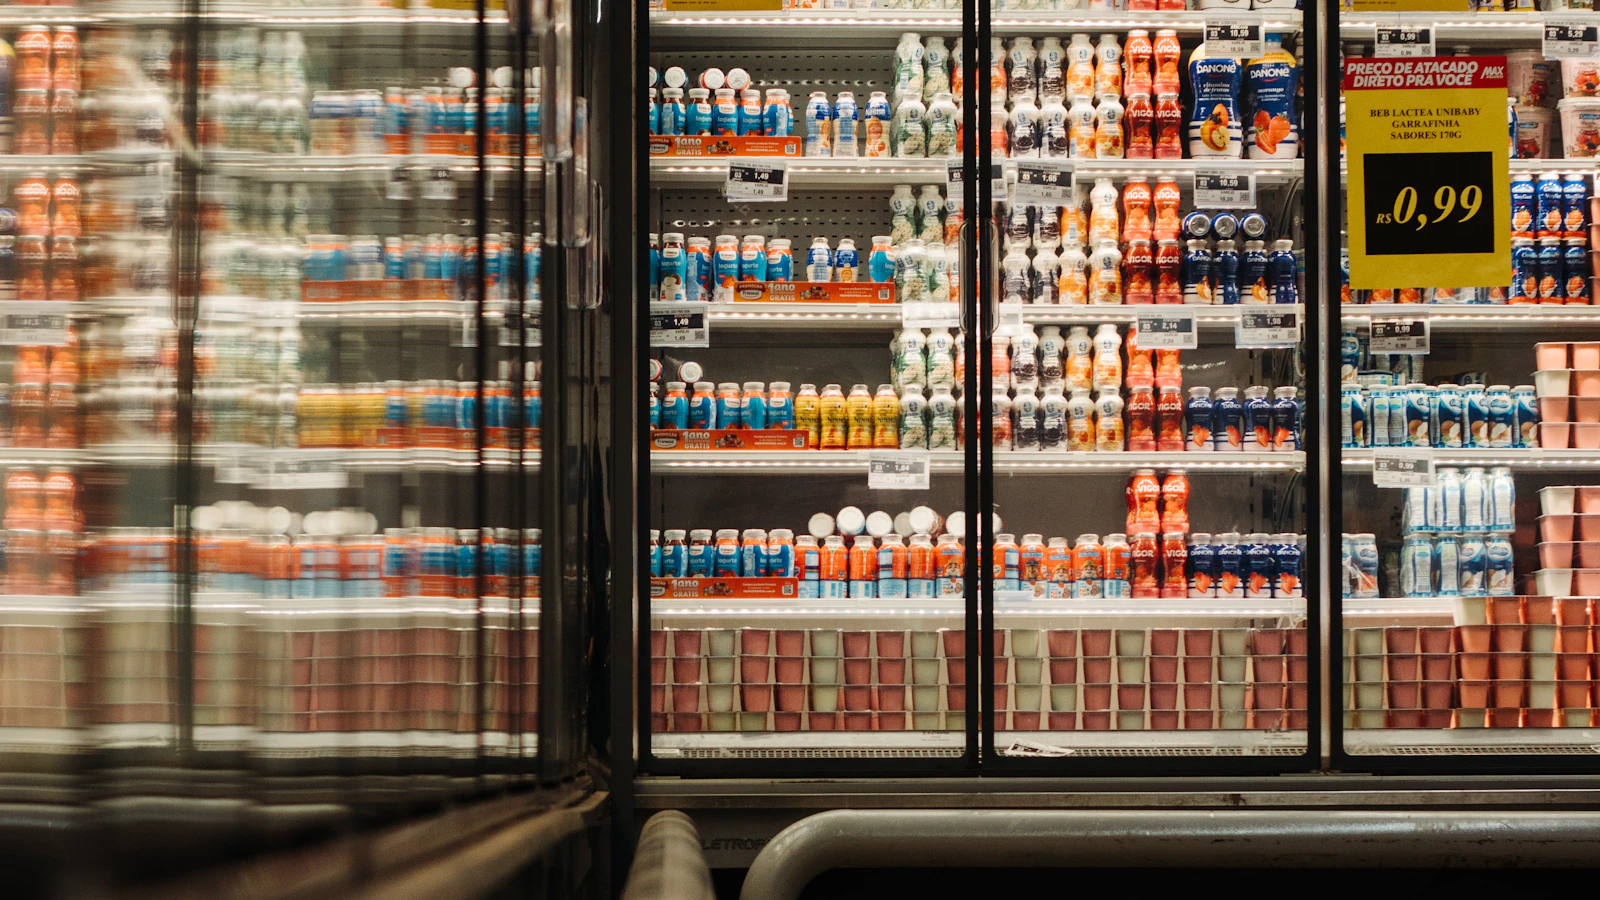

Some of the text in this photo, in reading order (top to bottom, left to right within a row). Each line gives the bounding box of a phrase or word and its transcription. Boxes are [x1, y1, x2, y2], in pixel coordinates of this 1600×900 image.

[1230, 29, 1249, 38] 10,59
[1400, 33, 1416, 41] 0,99
[1548, 30, 1584, 38] 03 5,29
[1347, 61, 1479, 76] PREÇO DE ATACADO
[1480, 66, 1505, 79] MAX
[1353, 72, 1473, 88] DIRETO PRA VOCÊ
[1370, 107, 1482, 117] BEB LACTEA UNIBABY
[1392, 120, 1460, 129] GARRAFINHA
[1390, 131, 1462, 140] SABORES 170G
[734, 171, 769, 180] 03 1,49
[953, 171, 961, 179] 03
[1042, 174, 1058, 182] 1,65
[1219, 179, 1239, 187] 10,59
[1124, 191, 1150, 200] VIGOR
[1393, 185, 1483, 231] 0,99
[1128, 256, 1153, 264] VIGOR
[673, 318, 689, 326] 1,49
[1161, 322, 1178, 330] 2,14
[1266, 317, 1282, 326] 1,98
[1394, 325, 1411, 334] 0,99
[1157, 403, 1182, 411] VIGOR
[894, 464, 910, 472] 1,84
[1398, 462, 1415, 470] 0,99
